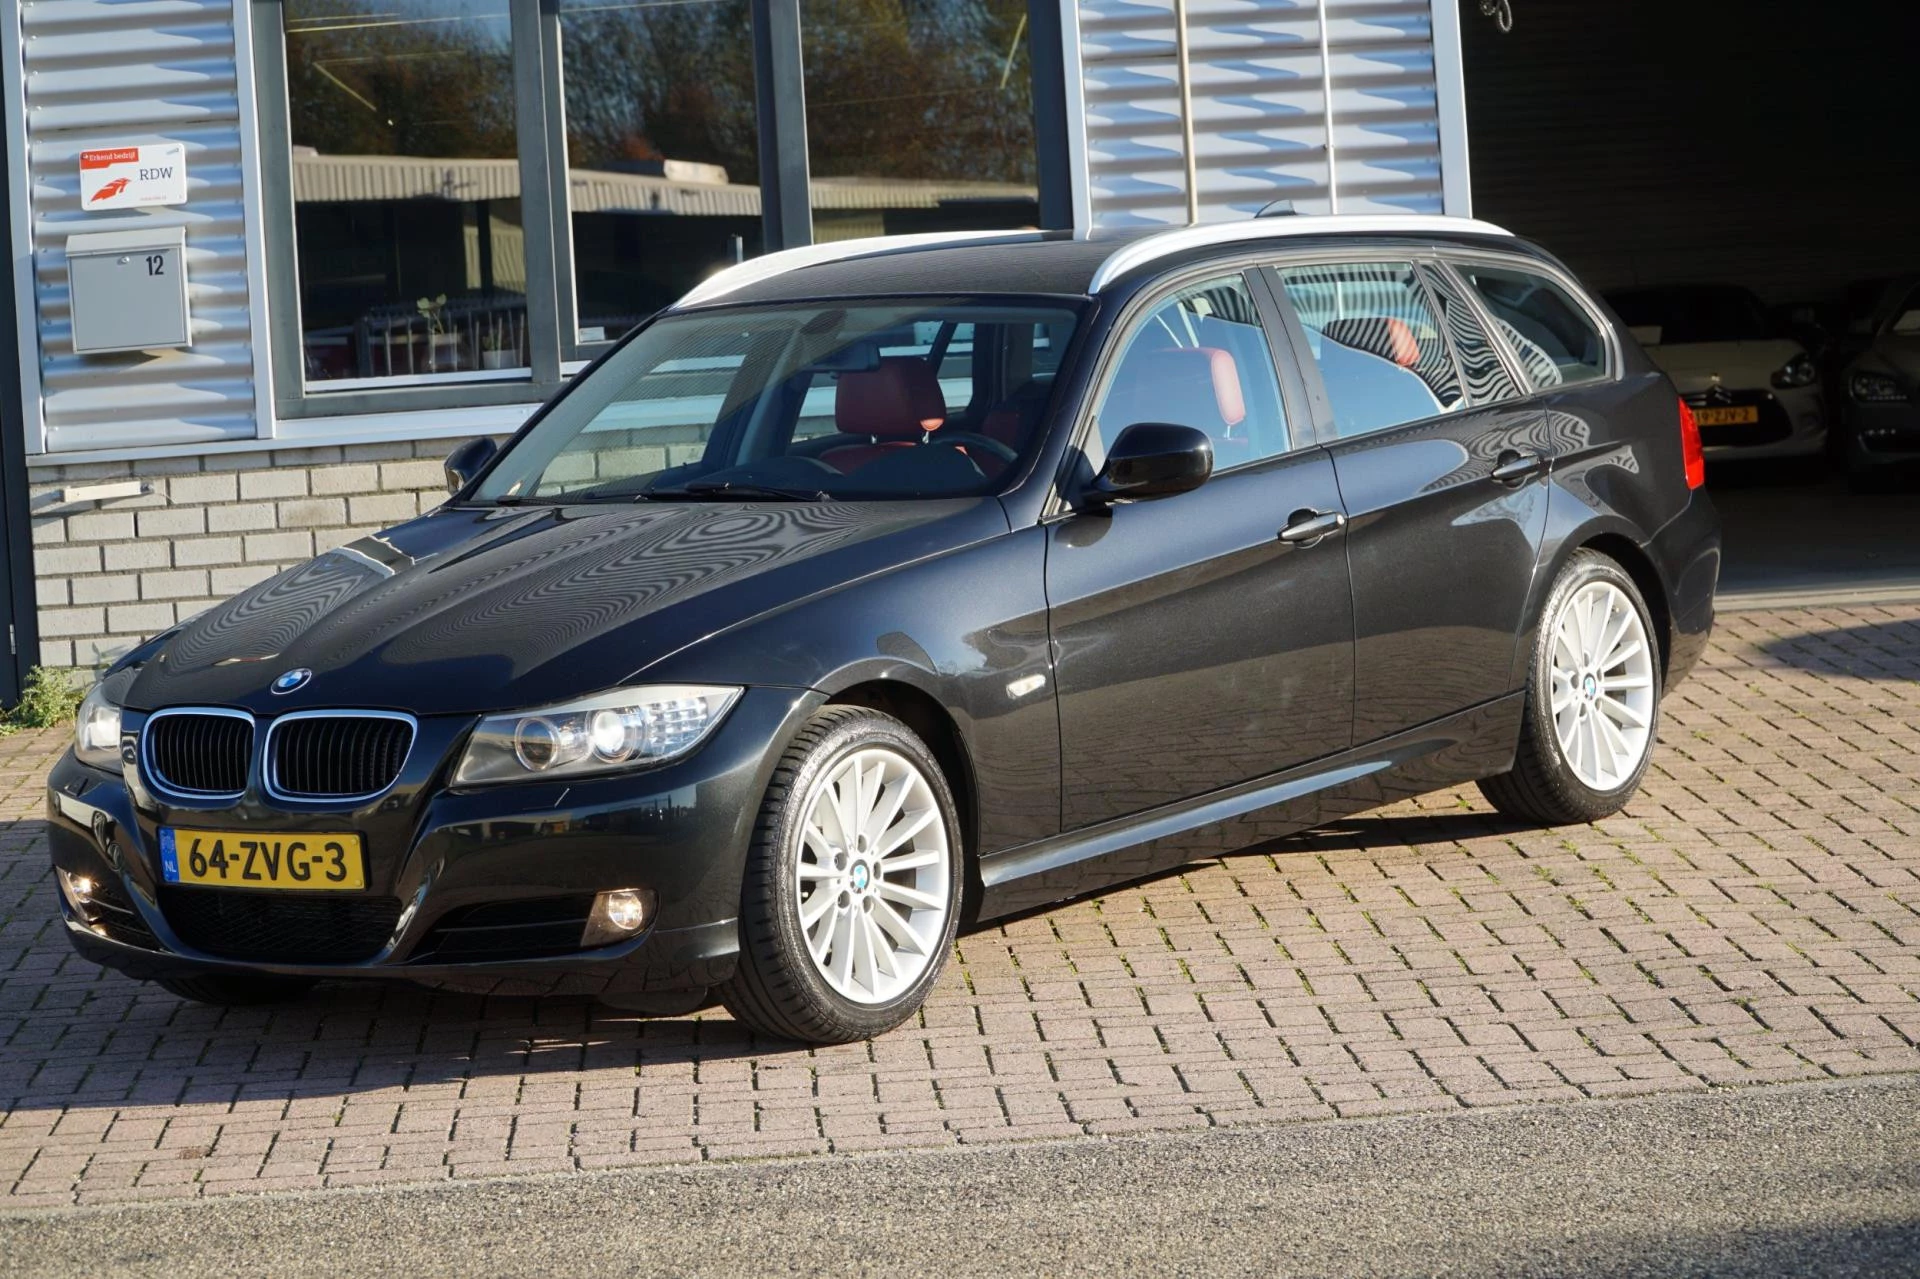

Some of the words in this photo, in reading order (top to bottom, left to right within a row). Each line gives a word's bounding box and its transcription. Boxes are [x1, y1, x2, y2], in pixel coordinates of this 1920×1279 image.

[139, 166, 173, 181] RDW
[145, 255, 164, 276] 12
[164, 860, 177, 873] NL
[189, 838, 347, 882] 64-ZVG-3
